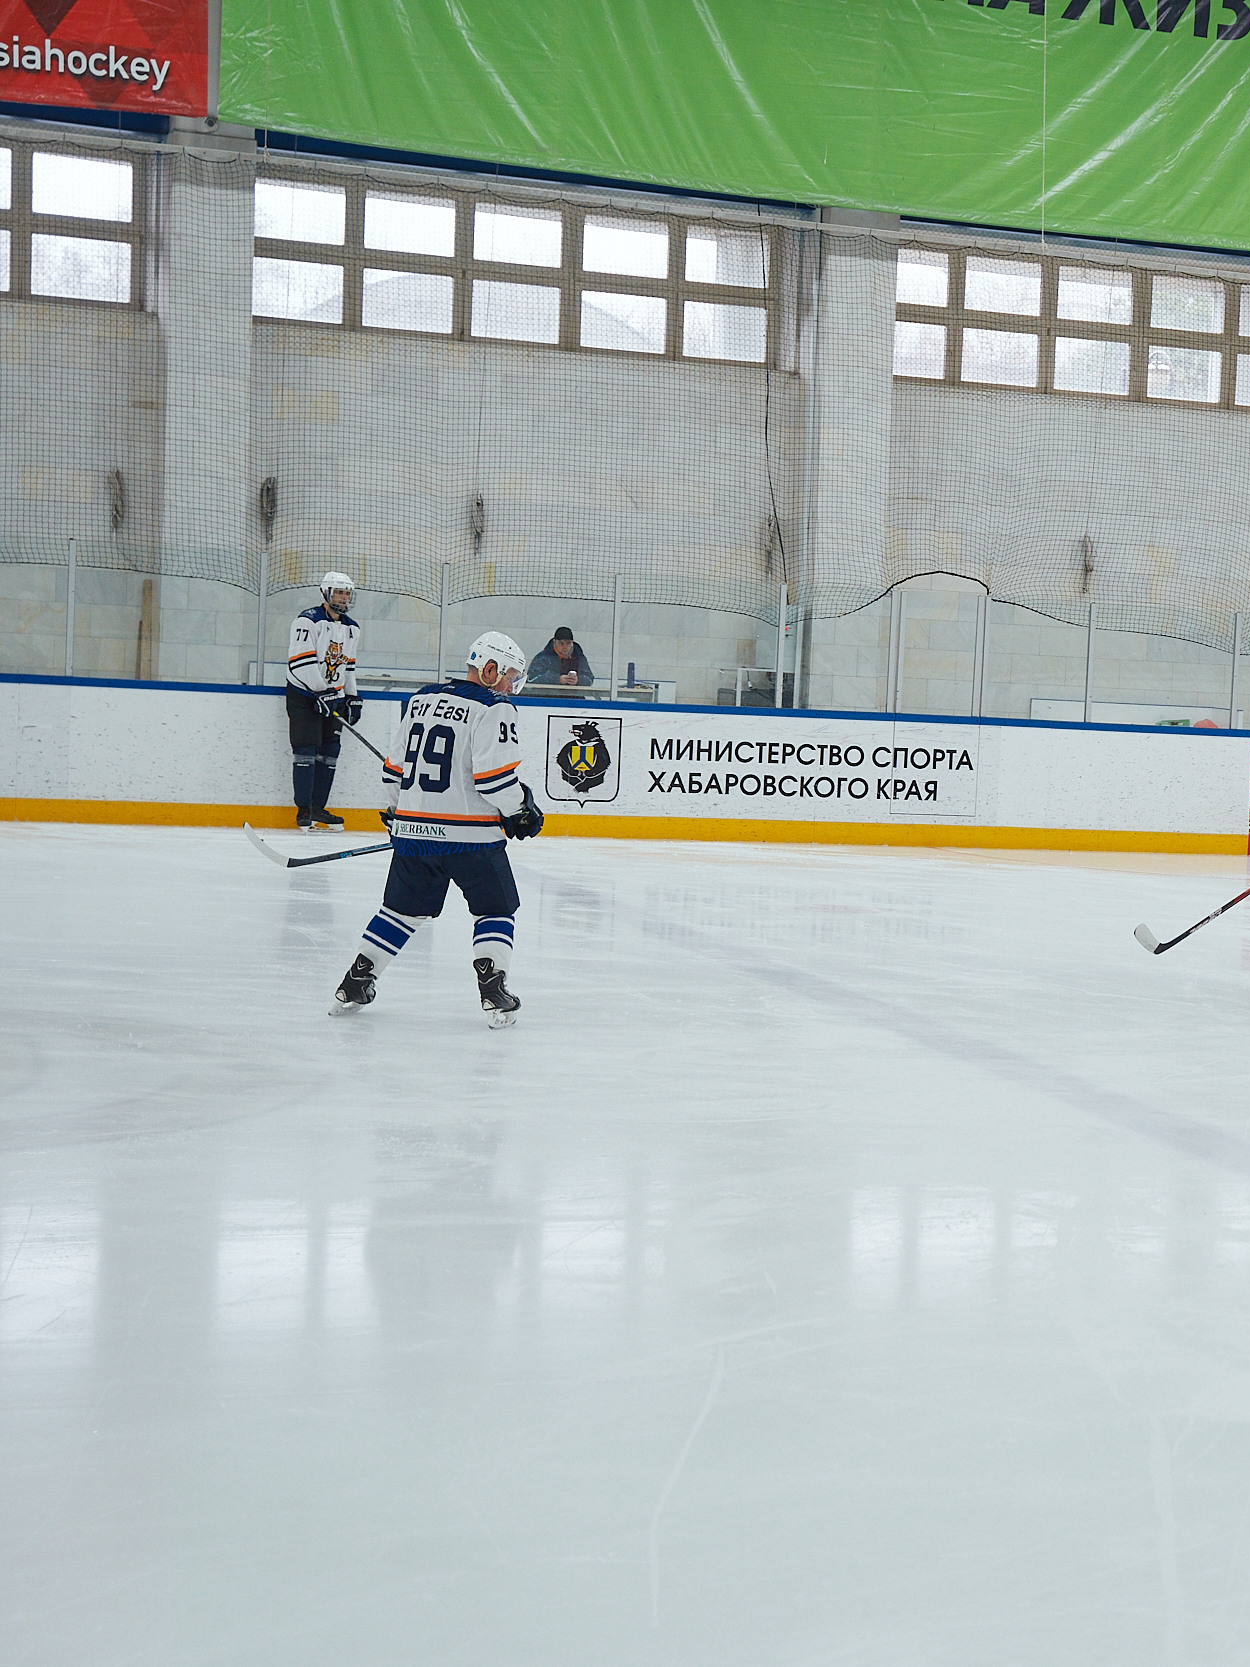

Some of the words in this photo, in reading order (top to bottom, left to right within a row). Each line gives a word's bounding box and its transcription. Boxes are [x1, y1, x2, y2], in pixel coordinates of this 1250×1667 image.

[296, 628, 309, 642] 77
[433, 699, 470, 724] East
[400, 722, 456, 793] 99
[650, 738, 865, 767] МИНИСТЕРСТВО
[872, 746, 974, 771] СПОРТА
[648, 771, 869, 800] ХАБАРОВСКОГО
[876, 778, 938, 802] КРАЯ
[399, 821, 447, 837] SBERBANK
